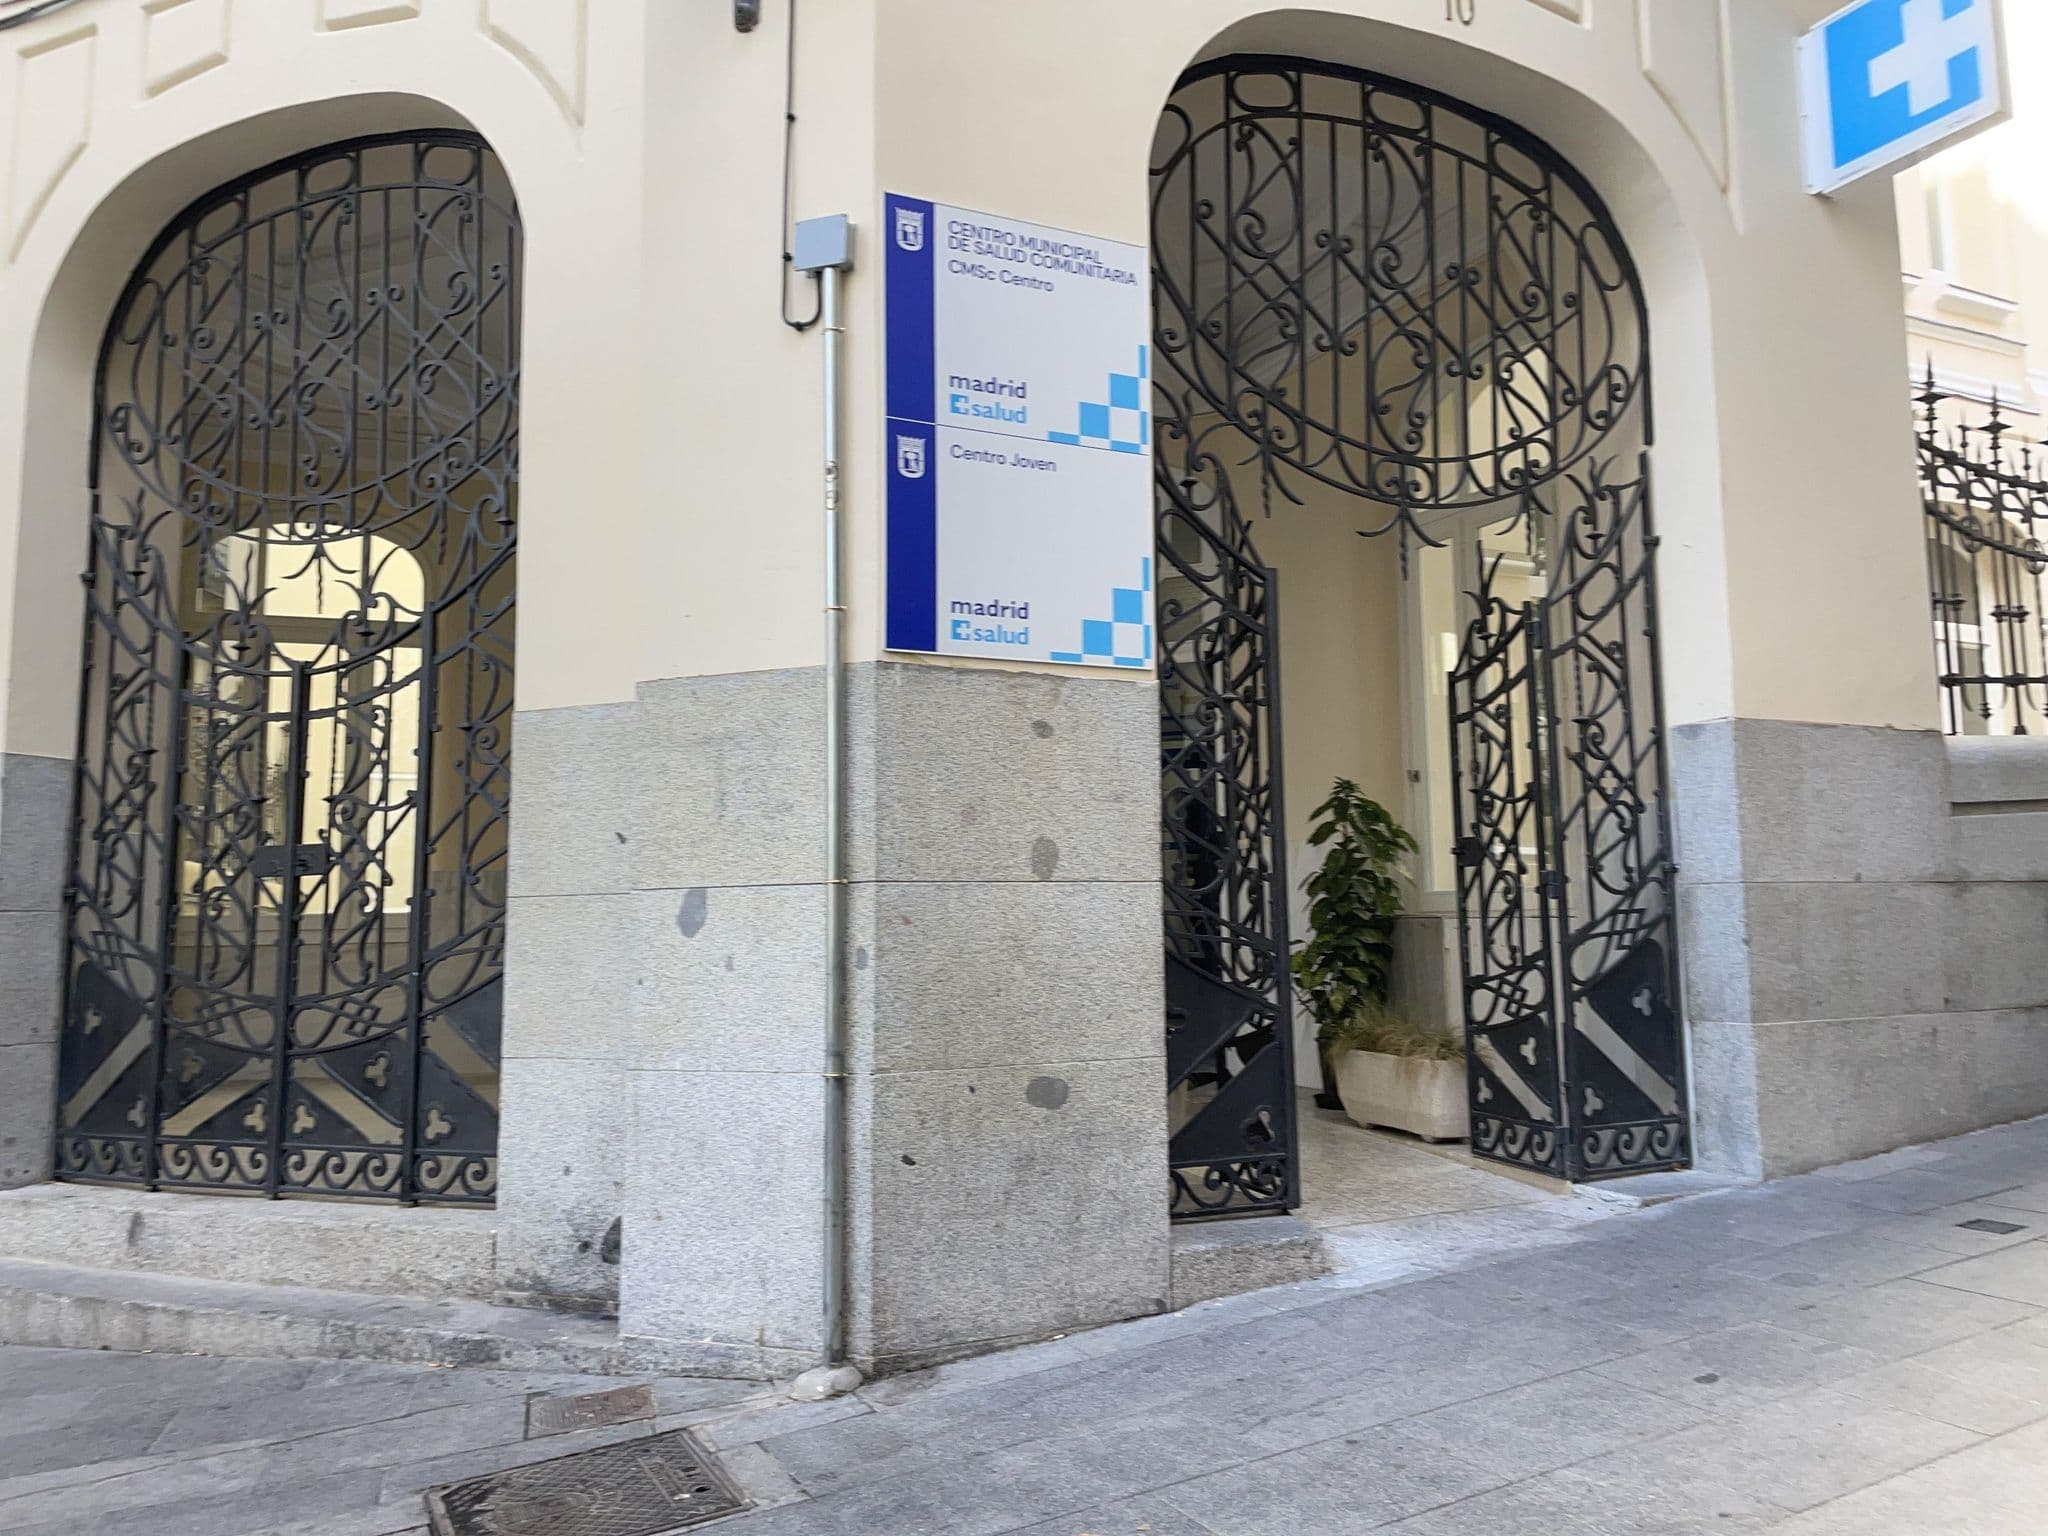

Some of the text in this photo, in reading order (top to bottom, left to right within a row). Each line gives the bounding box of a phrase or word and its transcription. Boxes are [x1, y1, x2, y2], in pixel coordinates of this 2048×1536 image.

[948, 220, 1103, 265] CENTRO MUNICIPAL
[948, 235, 1137, 285] DE SALUD COMUNITARIA
[948, 259, 1055, 292] CMSc Centro
[949, 375, 1027, 399] madrid
[972, 402, 1028, 425] salud
[950, 444, 1057, 472] Centro Joven
[951, 600, 1029, 620] madrid
[973, 623, 1030, 645] salud
